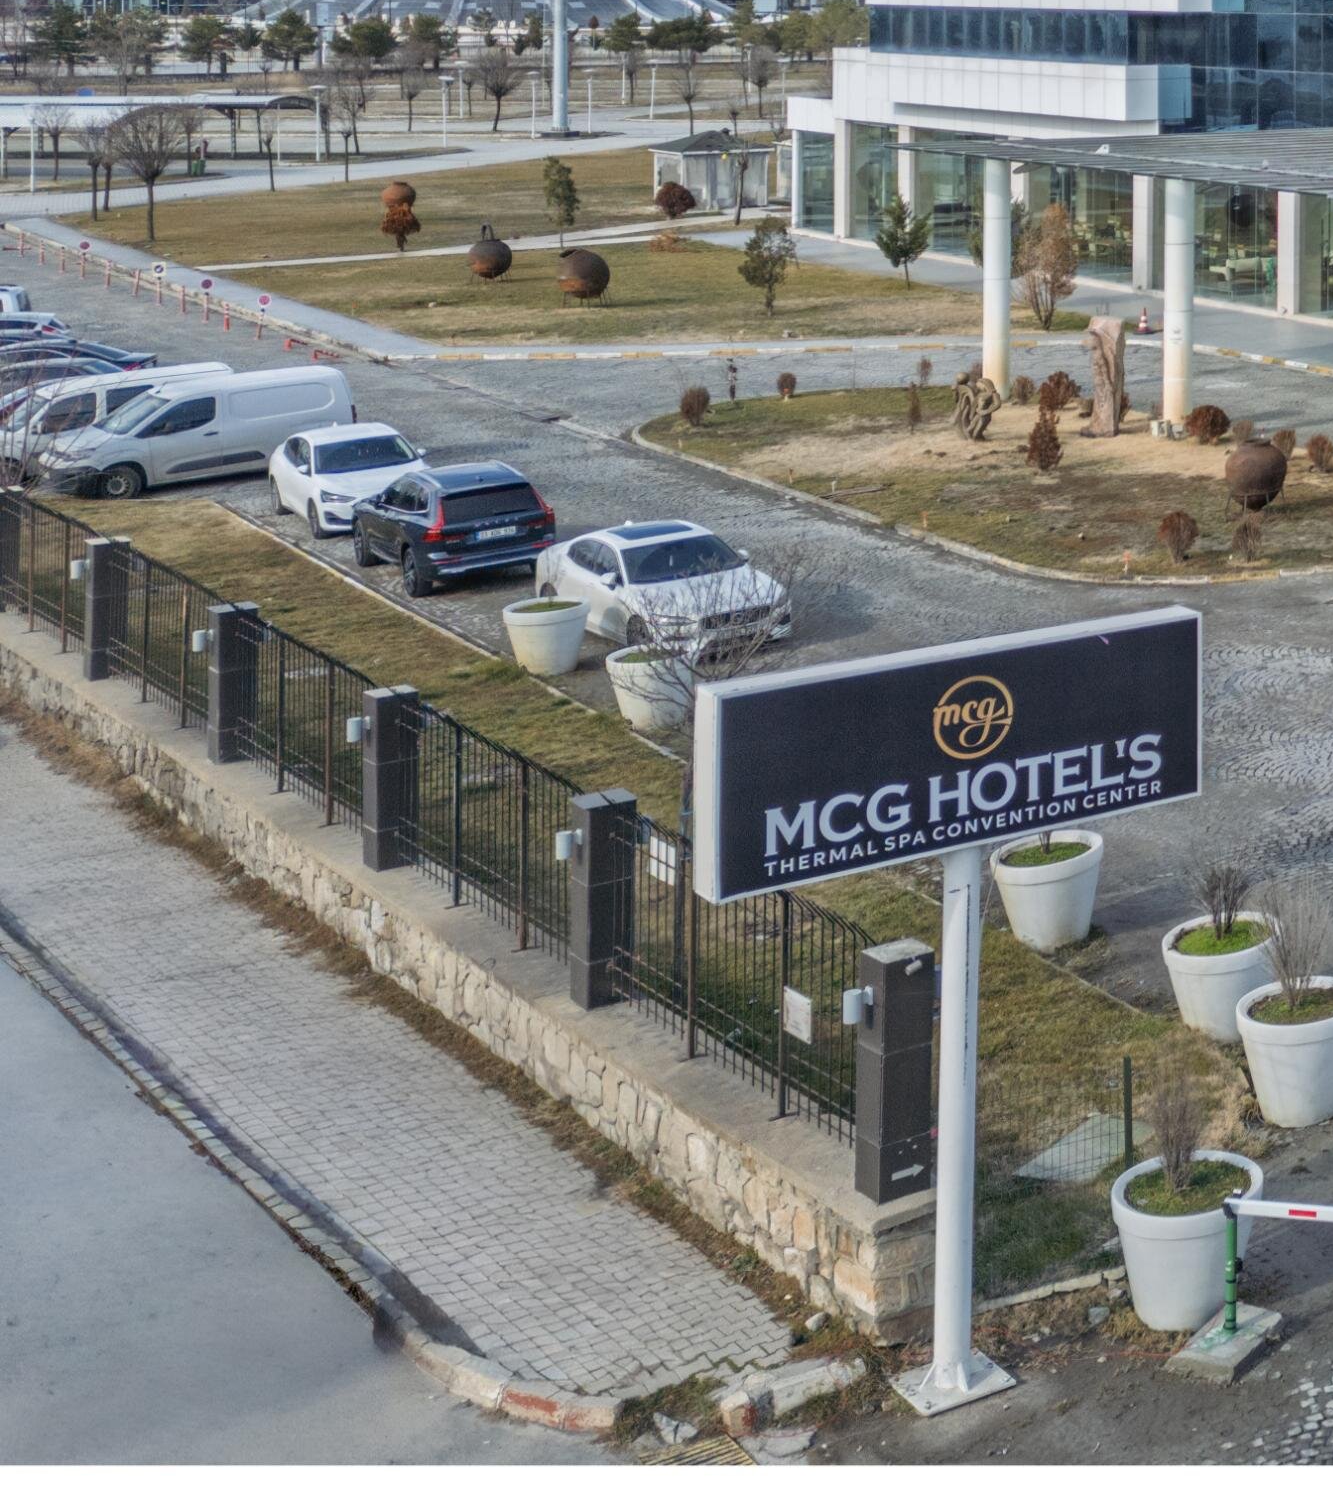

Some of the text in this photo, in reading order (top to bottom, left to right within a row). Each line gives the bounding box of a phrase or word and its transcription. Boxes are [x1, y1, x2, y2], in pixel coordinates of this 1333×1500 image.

[933, 695, 1012, 748] mcg
[763, 733, 1163, 858] MCG HOTEL'S
[763, 780, 1163, 877] THERMAL SPA CONVENTION CENTER
